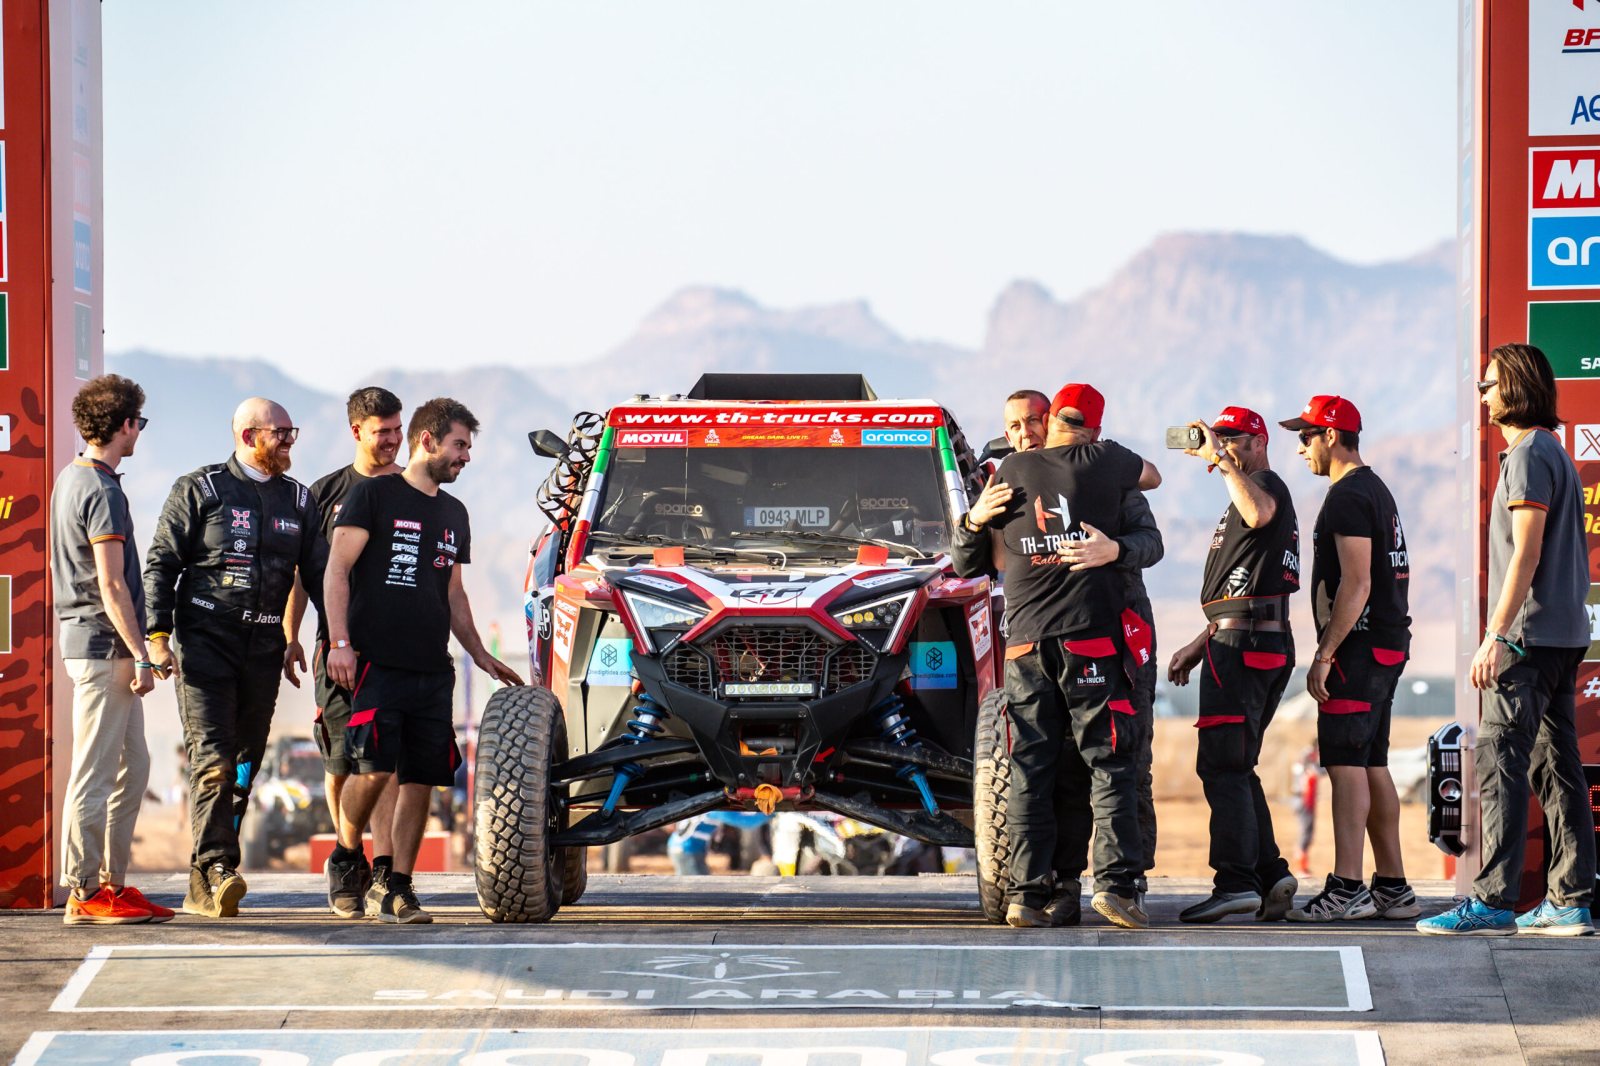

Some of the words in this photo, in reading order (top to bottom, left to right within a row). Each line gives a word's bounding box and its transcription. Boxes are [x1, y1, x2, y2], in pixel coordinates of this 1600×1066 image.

[1542, 159, 1600, 199] M
[624, 412, 935, 424] www.th-trucks.com
[621, 433, 684, 443] MOTUL
[865, 432, 928, 442] aramco
[760, 510, 790, 524] 0943
[796, 510, 825, 524] MLP
[396, 521, 421, 530] MOTUL
[242, 610, 252, 621] F.
[1077, 676, 1105, 684] TH-TRUCKS
[373, 989, 656, 1000] SAUDI
[686, 989, 1052, 1000] ARABIA
